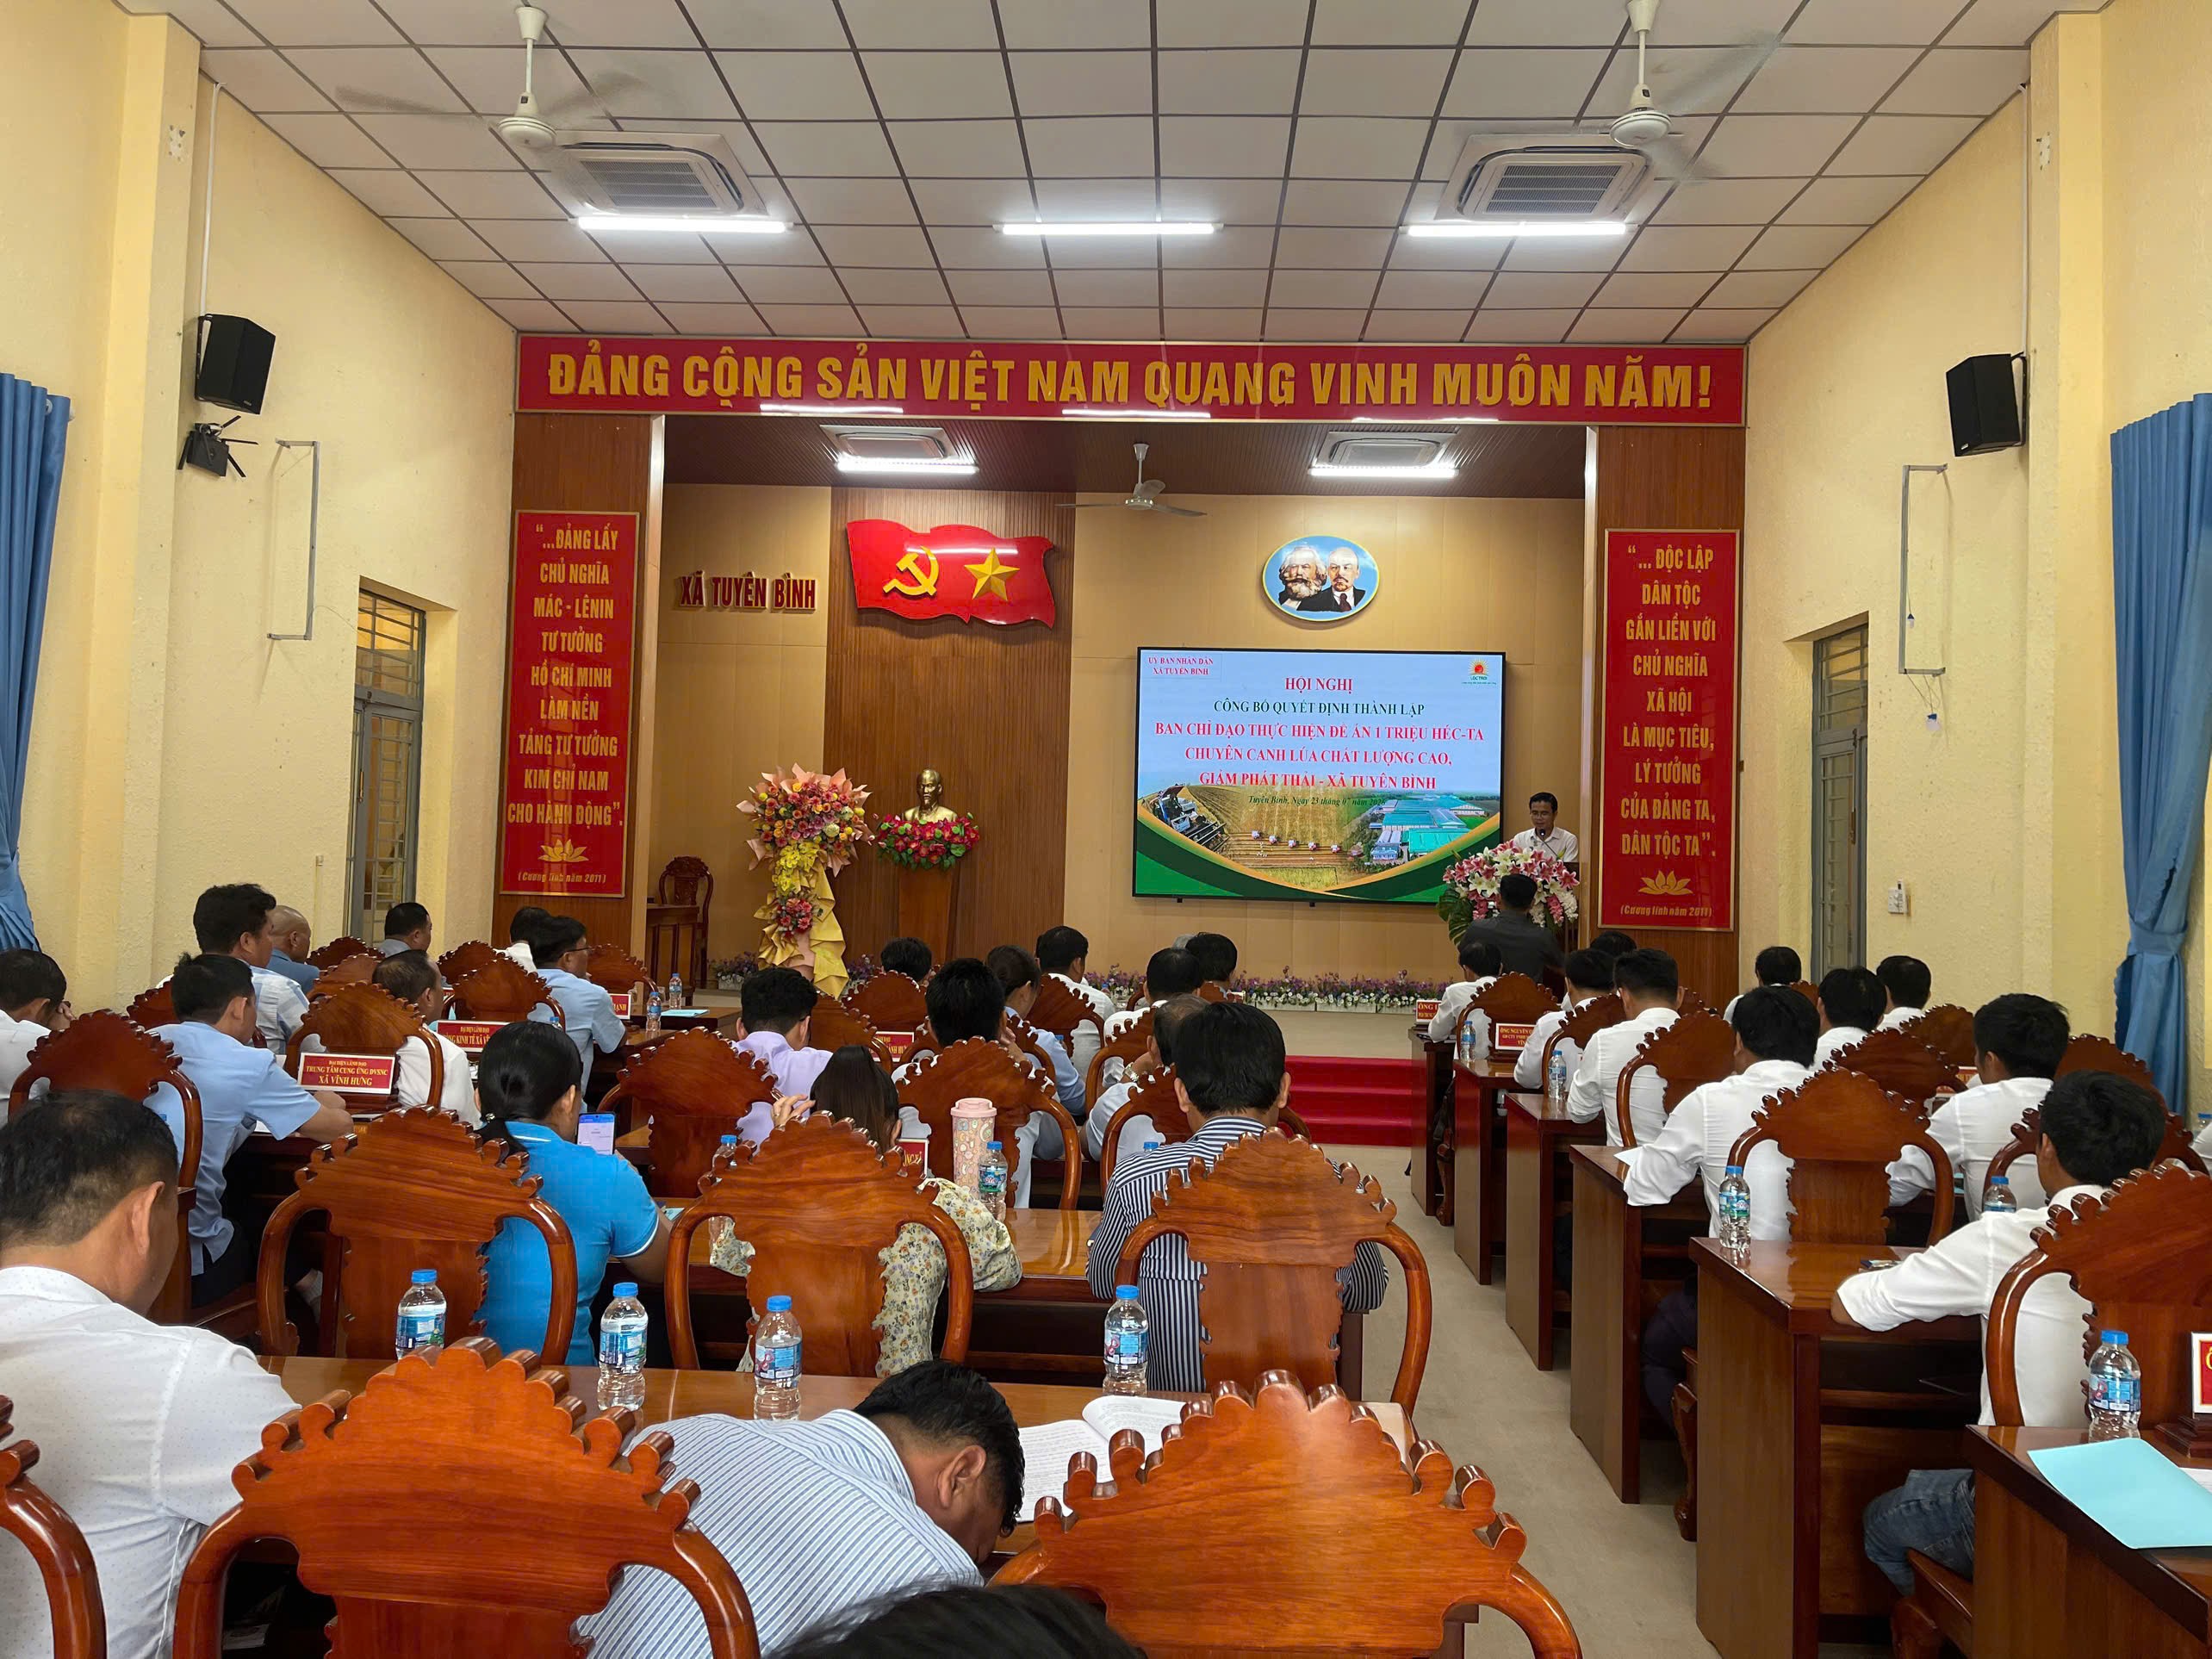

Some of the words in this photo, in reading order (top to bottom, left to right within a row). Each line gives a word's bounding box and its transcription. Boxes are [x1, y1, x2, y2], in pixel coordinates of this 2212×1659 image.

[548, 339, 668, 397] ĐẢNG
[682, 346, 803, 407] CỘNG
[817, 343, 906, 400] SẢN
[920, 350, 1014, 410] VIỆT
[1028, 360, 1128, 404] NAM
[1144, 360, 1296, 407] QUANG
[1310, 362, 1417, 405] VINH
[1432, 353, 1570, 407] MUÔN
[1585, 354, 1711, 407] NĂM!
[594, 522, 618, 550] LẤY
[540, 557, 566, 584] CHỦ
[569, 561, 610, 585] NGHĨA
[1656, 544, 1684, 573] ĐỘC
[1687, 544, 1714, 573] LẬP
[680, 569, 705, 606] XÃ
[711, 571, 768, 608] TUYÊN
[774, 572, 817, 610] BÌNH
[1643, 580, 1671, 605] DÂN
[1675, 580, 1701, 609] TỘC
[533, 593, 562, 618] MÁC
[575, 594, 614, 619] LÊNIN
[541, 631, 559, 652] TƯ
[561, 625, 603, 653] TƯỞNG
[1625, 612, 1655, 641] GẮN
[1658, 612, 1689, 641] LIỀN
[1693, 616, 1716, 641] VỚI
[531, 658, 549, 686] HỒ
[552, 663, 575, 687] CHÍ
[577, 667, 612, 687] MINH
[1633, 649, 1661, 676] CHỦ
[1664, 652, 1708, 676] NGHĨA
[1284, 676, 1312, 693] HỘI
[1315, 678, 1353, 694] NGHỊ
[540, 696, 569, 720] LÀM
[571, 693, 599, 721] NỀN
[1214, 698, 1249, 713] CÔNG
[1253, 699, 1269, 713] BỐ
[1319, 702, 1349, 716] ĐỊNH
[1352, 700, 1396, 715] THÀNH
[1401, 702, 1425, 718] LẬP
[1647, 687, 1666, 712] XÃ
[1668, 687, 1693, 716] HỘI
[519, 727, 552, 755] TẢNG
[556, 733, 574, 755] TƯ
[575, 729, 618, 757] TƯỞNG
[1155, 722, 1183, 735] BAN
[1187, 719, 1212, 736] CHỈ
[1215, 724, 1245, 739] ĐẠO
[1248, 723, 1288, 740] THỰC
[1291, 724, 1326, 740] HIỆN
[1329, 722, 1347, 738] ĐỀ
[1351, 724, 1371, 738] ÁN
[1375, 727, 1380, 738] 1
[1384, 725, 1427, 743] TRIỆU
[1432, 724, 1483, 741] HÉC-TA
[1623, 723, 1640, 748] LÀ
[1643, 726, 1675, 752] MỤC
[1679, 724, 1714, 752] TIÊU,
[1185, 744, 1243, 761] CHUYÊN
[1246, 749, 1286, 761] CANH
[1289, 746, 1318, 762] LÚA
[1320, 747, 1360, 763] CHẤT
[1364, 749, 1414, 766] LƯỢNG
[1418, 751, 1452, 766] CAO,
[524, 768, 550, 789] KIM
[553, 763, 575, 790] CHỈ
[578, 771, 609, 792] NAM
[1199, 769, 1240, 786] GIẢM
[1241, 770, 1281, 786] PHÁT
[1282, 771, 1315, 786] THẢI
[1327, 772, 1346, 787] XÃ
[1350, 773, 1397, 789] TUYÊN
[1401, 774, 1436, 790] BÌNH
[1635, 758, 1651, 783] LÝ
[1655, 755, 1701, 784] TƯỞNG
[507, 803, 533, 823] CHO
[537, 799, 572, 824] HÀNH
[1620, 792, 1649, 819] CỦA
[1652, 792, 1691, 821] ĐẢNG
[1694, 799, 1716, 823] TA,
[1622, 830, 1650, 855] DÂN
[1654, 830, 1681, 859] TỘC
[319, 1074, 328, 1084] XÃ
[331, 1074, 349, 1085] VĨNH
[351, 1076, 372, 1086] HƯNG
[326, 1065, 339, 1073] TÂM
